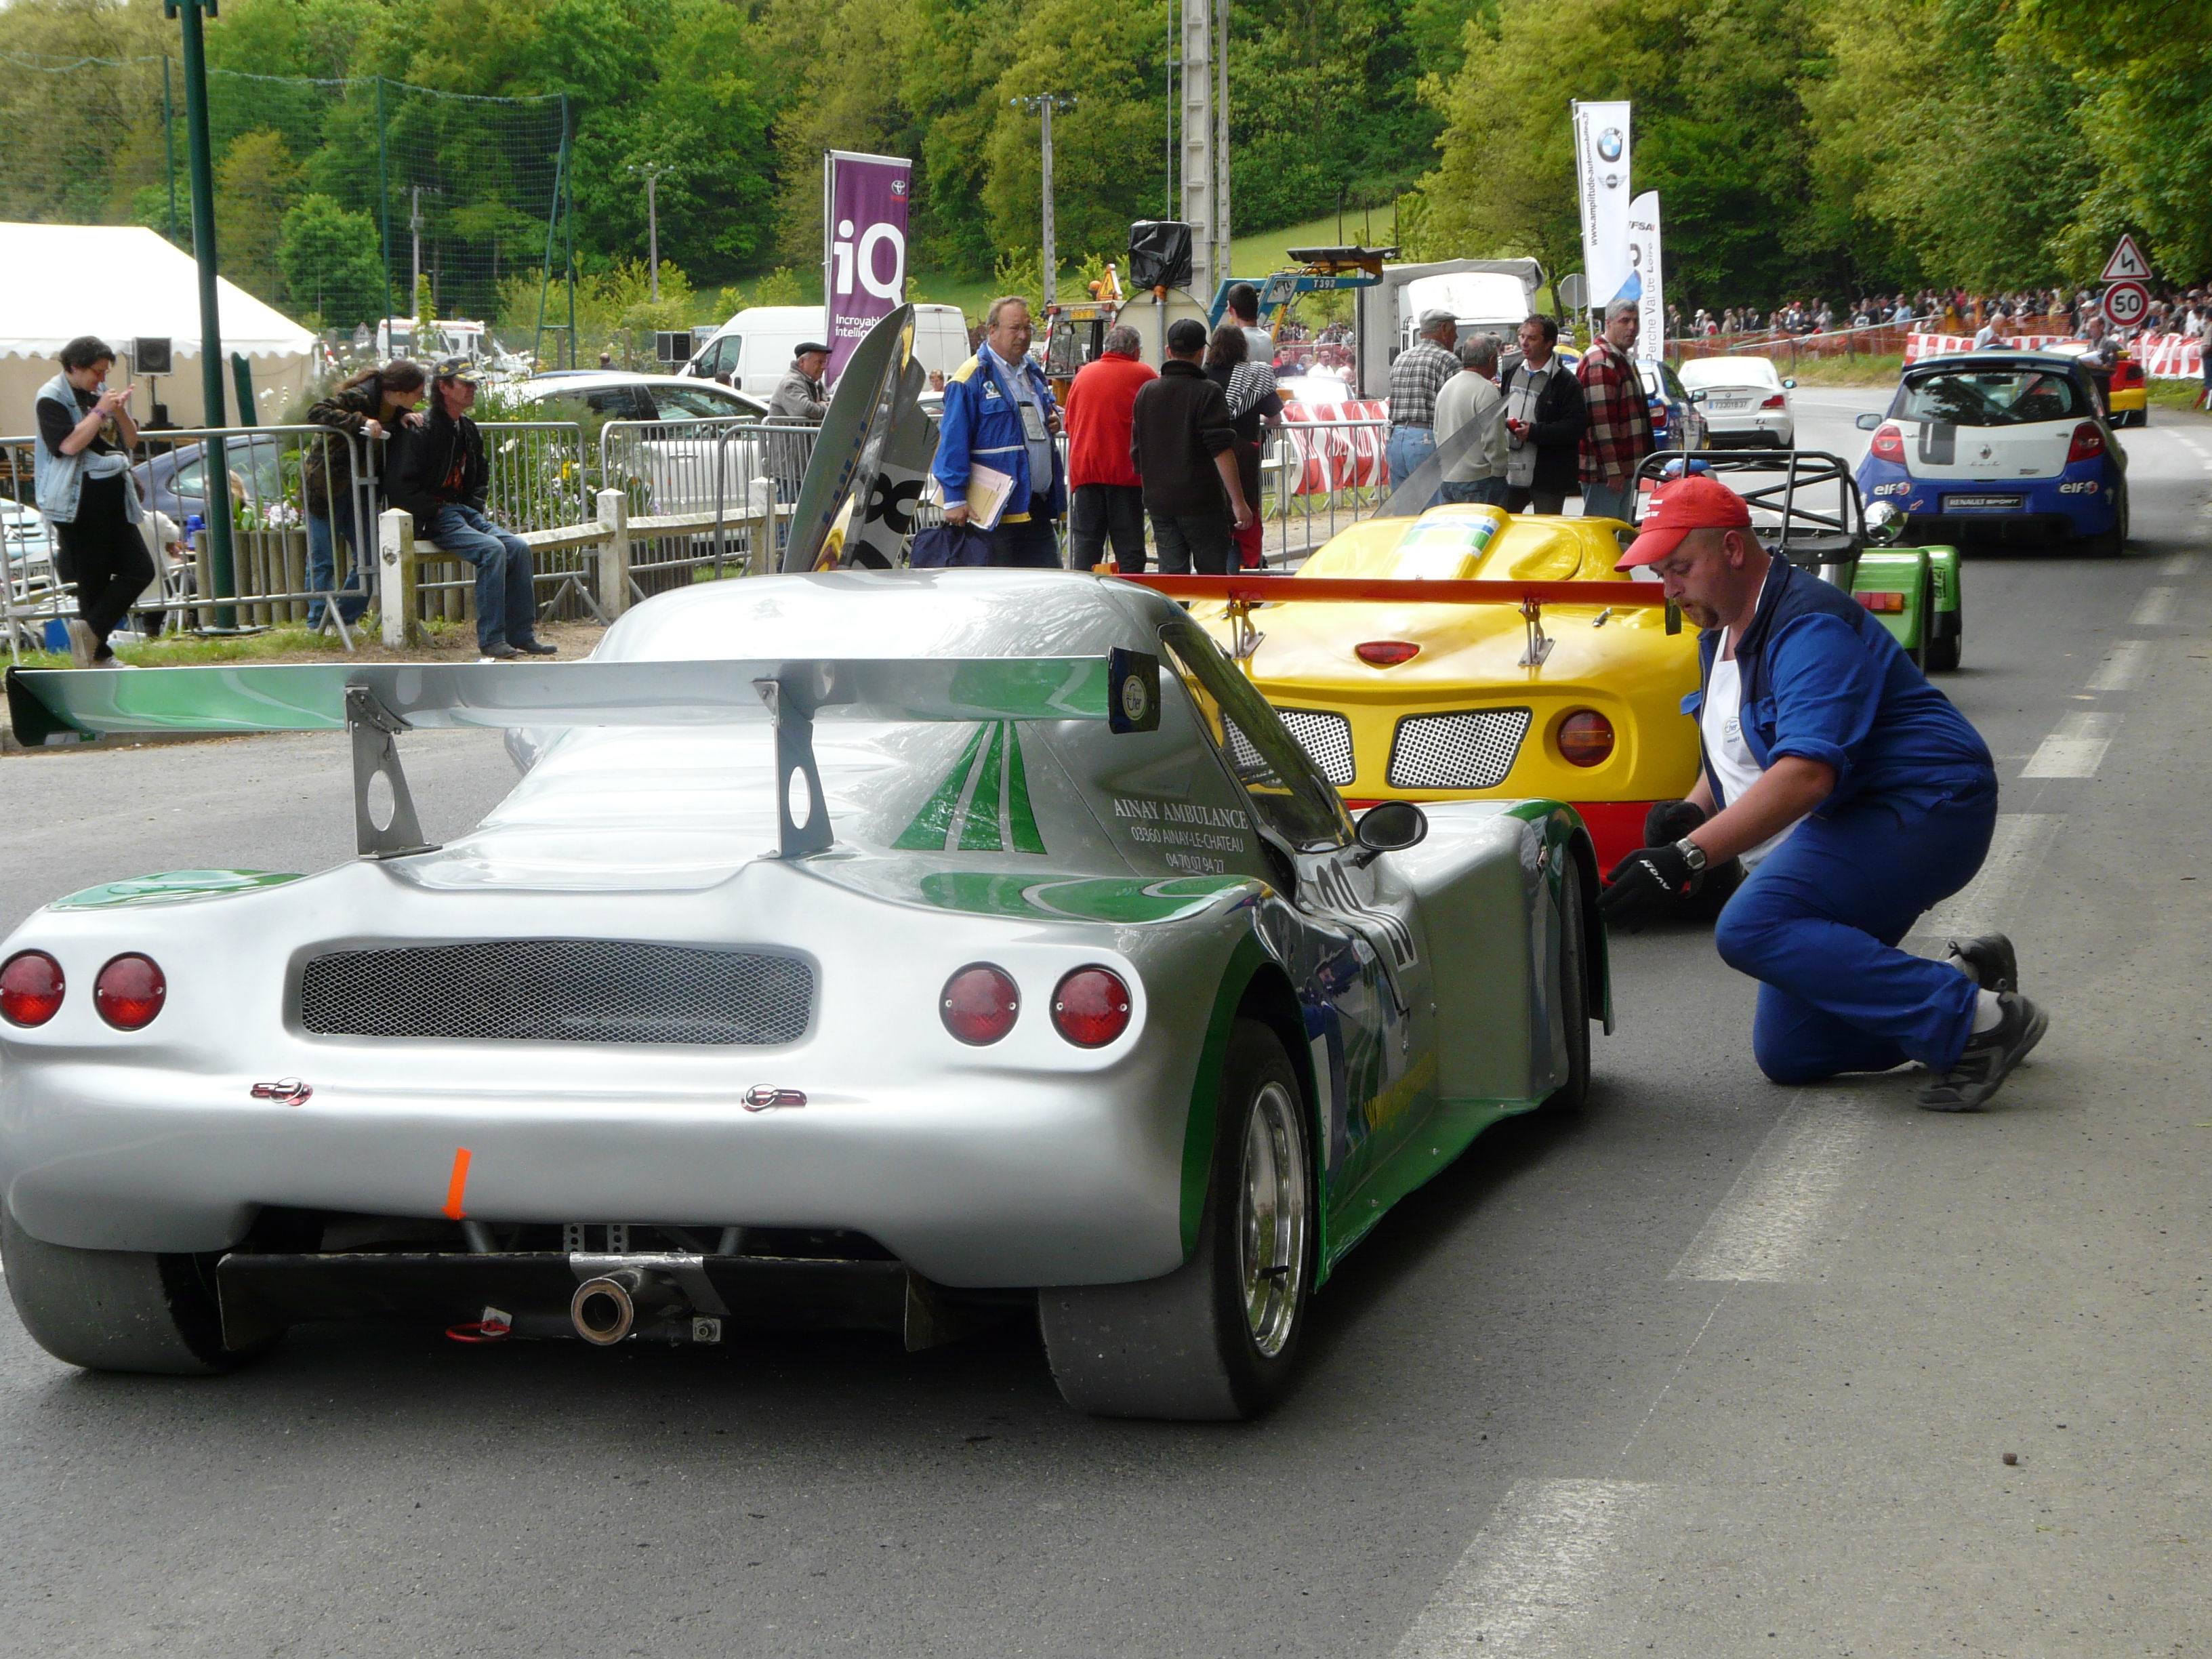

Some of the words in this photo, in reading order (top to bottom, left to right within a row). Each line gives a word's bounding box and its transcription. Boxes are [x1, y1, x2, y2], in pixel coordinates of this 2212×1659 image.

[833, 220, 905, 308] iQ
[1645, 296, 1656, 315] Val
[2114, 294, 2141, 313] 50
[1873, 482, 1896, 495] elf
[2060, 481, 2085, 495] elf
[1949, 497, 1986, 507] RENAULT
[1986, 497, 2020, 506] SPORT
[1113, 798, 1160, 820] AINAY
[1163, 802, 1248, 830] AMBULANCE
[1131, 826, 1162, 843] 03360
[1163, 830, 1244, 853] AINAY-LE-CHATEAU
[1166, 853, 1178, 867] 04
[1178, 855, 1190, 869] 70
[1202, 857, 1214, 872] 94
[1214, 859, 1224, 874] 27
